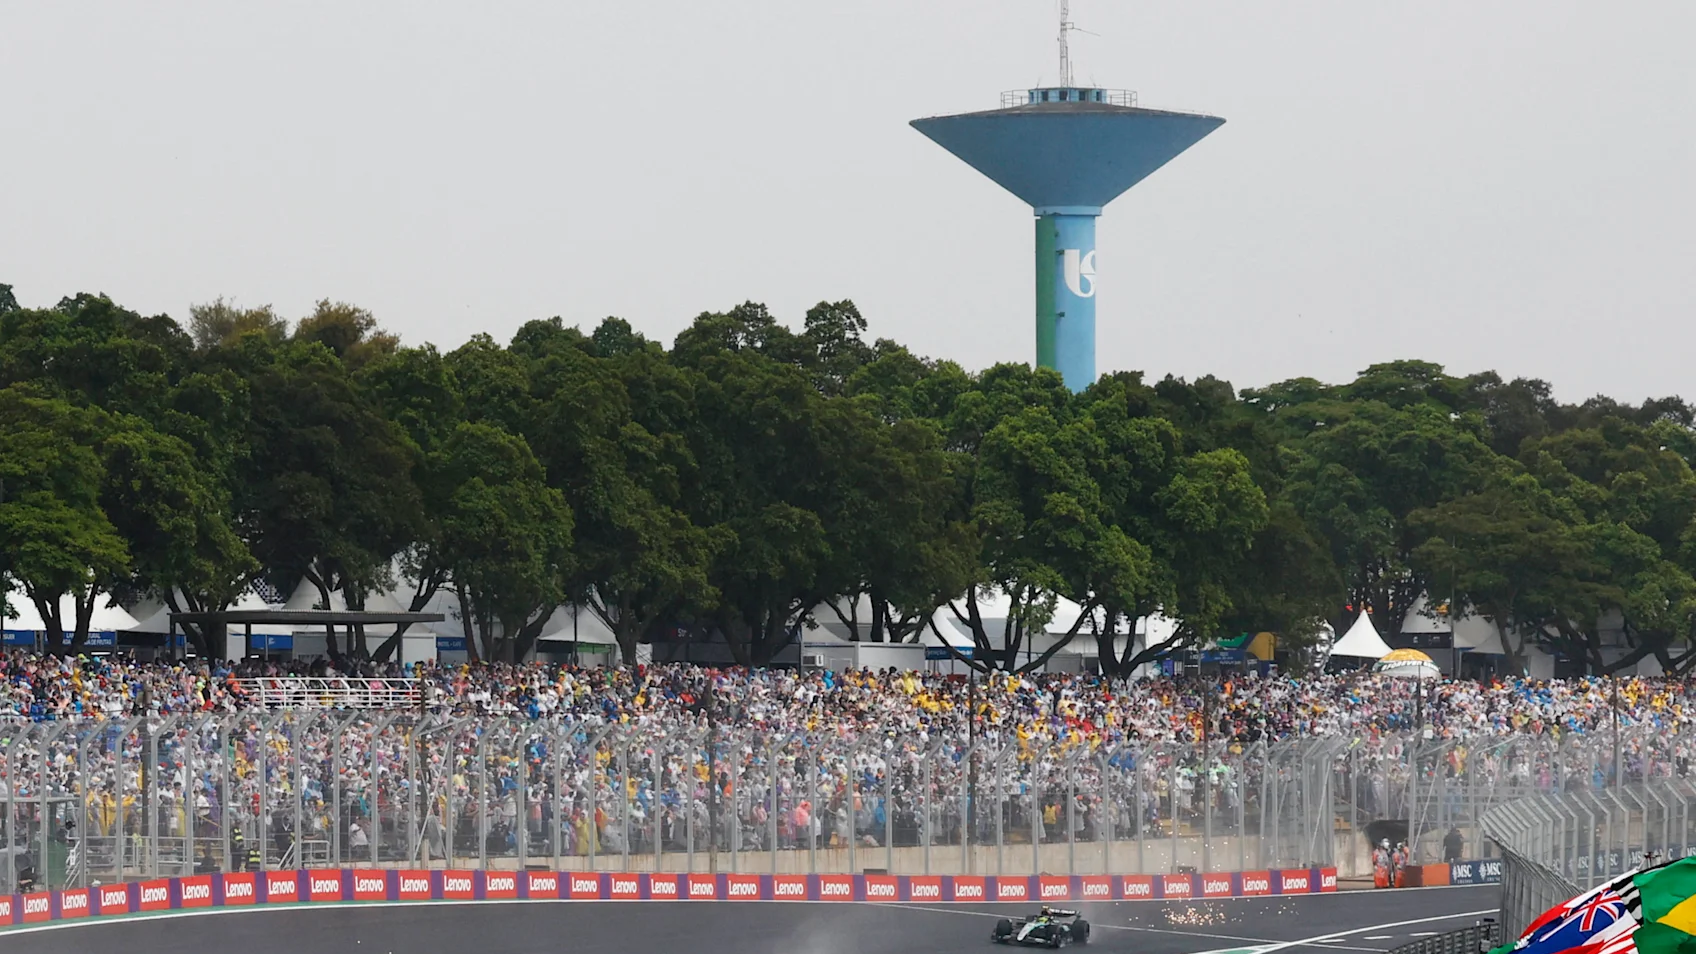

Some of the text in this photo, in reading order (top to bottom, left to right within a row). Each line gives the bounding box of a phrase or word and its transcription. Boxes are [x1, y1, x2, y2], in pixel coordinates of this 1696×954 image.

[1457, 865, 1472, 878] MSC
[1486, 862, 1501, 876] MSC
[225, 881, 252, 897] Lenovo
[268, 879, 295, 895] Lenovo
[311, 877, 338, 893] Lenovo
[355, 876, 383, 892] Lenovo
[400, 876, 428, 892] Lenovo
[444, 875, 471, 891] Lenovo
[487, 876, 514, 890] Lenovo
[530, 876, 556, 890] Lenovo
[572, 877, 597, 892] Lenovo
[612, 878, 637, 893] Lenovo
[651, 879, 676, 894] Lenovo
[690, 880, 713, 895] Lenovo
[729, 880, 756, 895] Lenovo
[775, 881, 803, 894] Lenovo
[821, 880, 850, 895] Lenovo
[867, 881, 895, 896] Lenovo
[912, 883, 939, 896] Lenovo
[955, 883, 982, 896] Lenovo
[998, 883, 1025, 896] Lenovo
[1041, 883, 1067, 896] Lenovo
[1083, 882, 1109, 896] Lenovo
[1124, 882, 1149, 896] Lenovo
[1164, 881, 1190, 894] Lenovo
[1204, 880, 1229, 893] Lenovo
[1243, 879, 1268, 891] Lenovo
[1283, 876, 1307, 889] Lenovo
[101, 890, 126, 906] Lenovo
[141, 886, 167, 902] Lenovo
[182, 883, 209, 899] Lenovo
[24, 897, 48, 913] Lenovo
[62, 893, 87, 909] Lenovo
